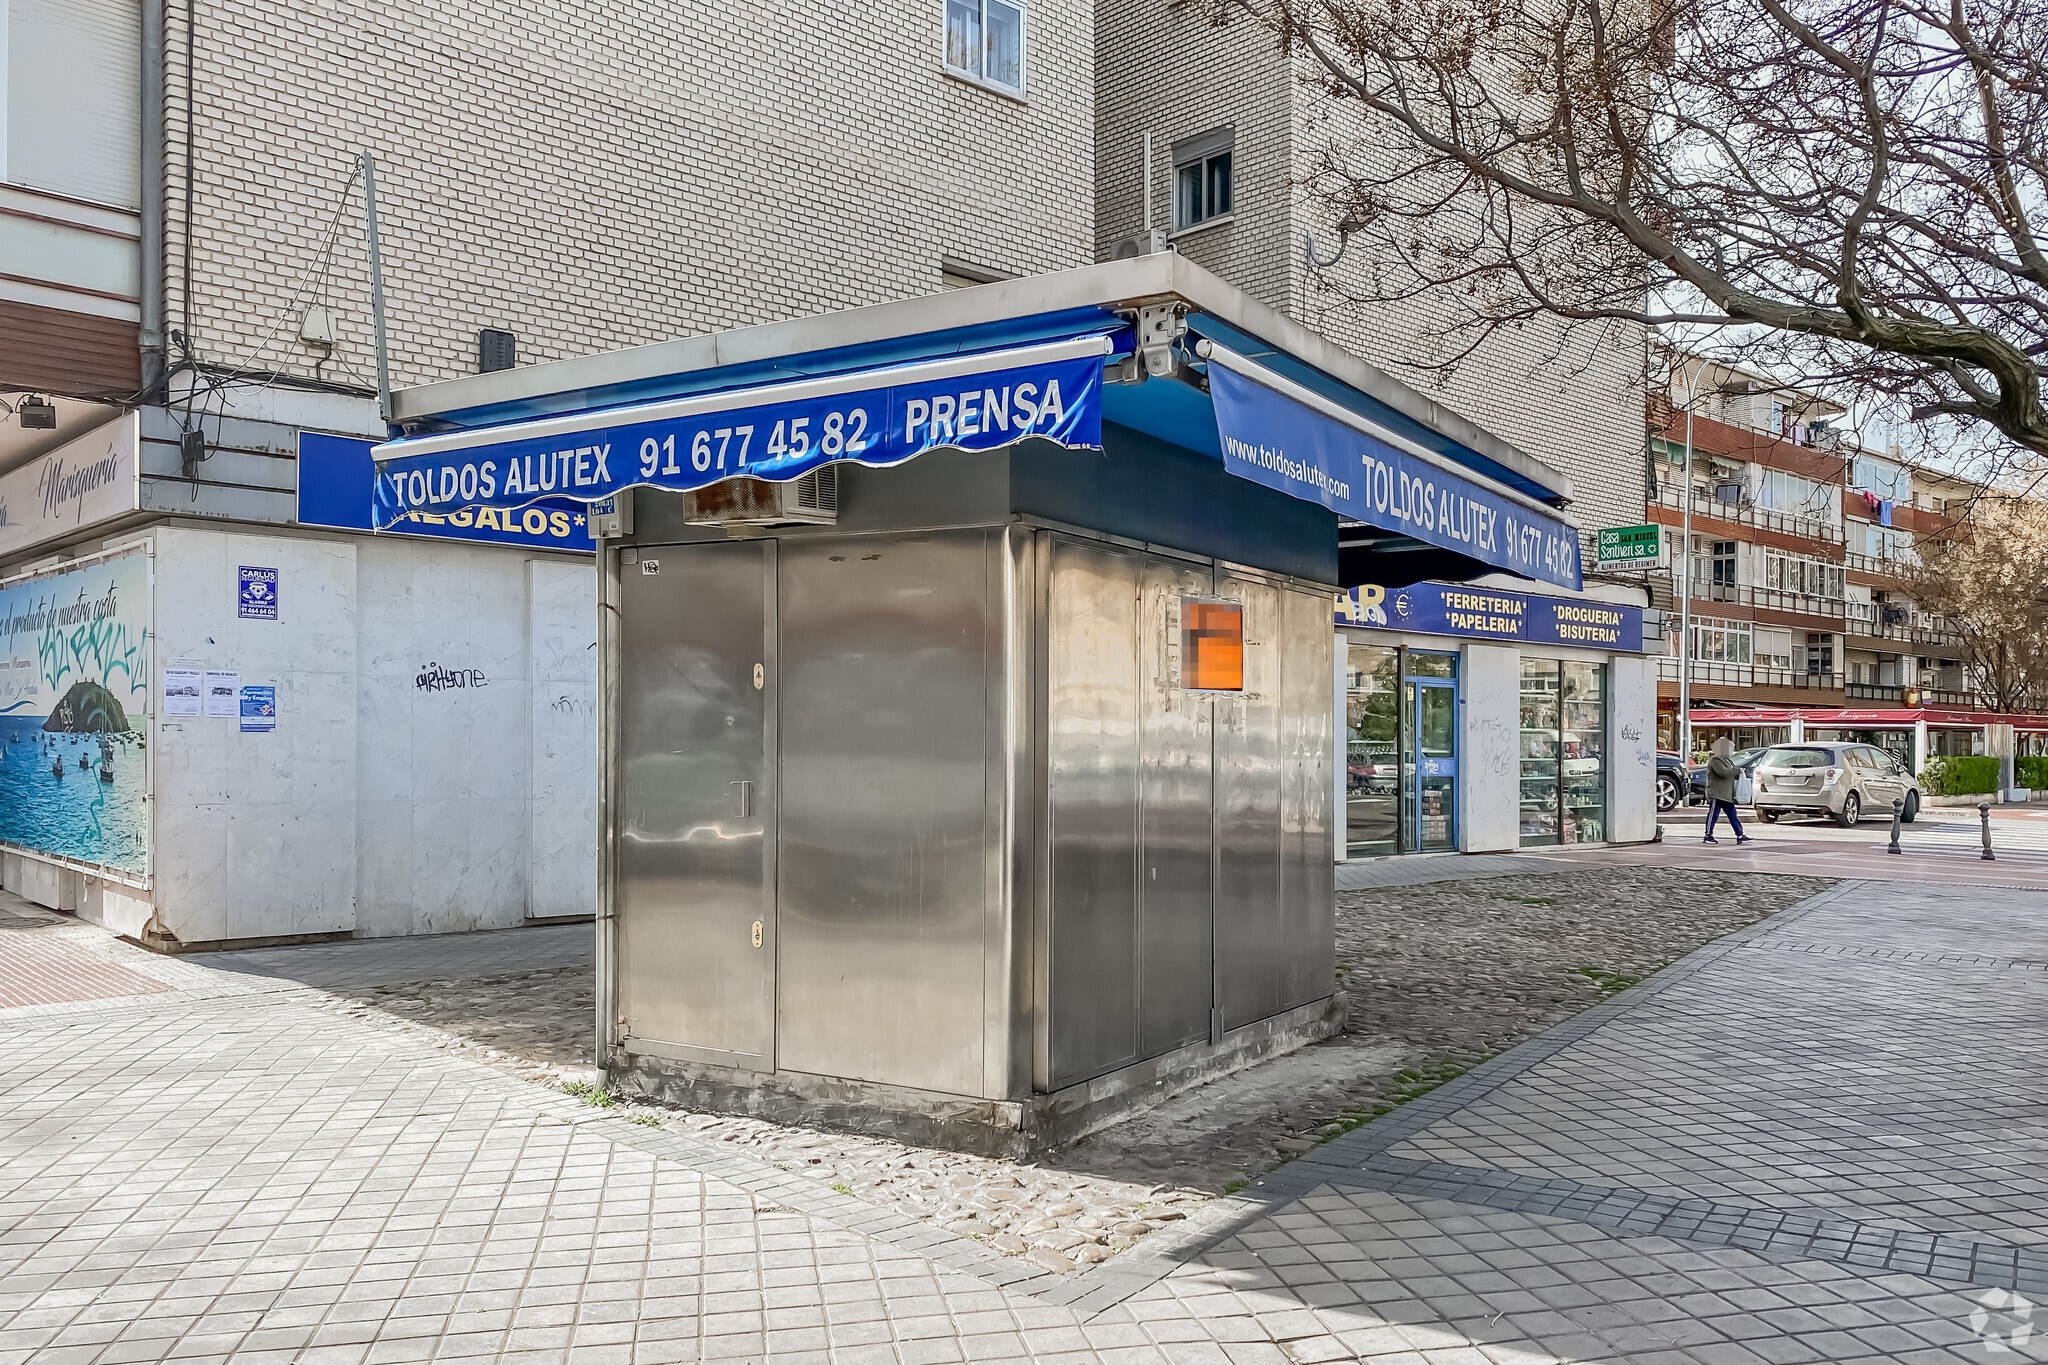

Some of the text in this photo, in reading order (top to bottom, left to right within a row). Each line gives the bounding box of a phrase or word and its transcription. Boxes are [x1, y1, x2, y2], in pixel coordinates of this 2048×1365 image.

[392, 379, 1065, 507] TOLDOS ALUTEX 91 677 45 82 PRENSA
[1225, 434, 1350, 501] www.toldosalutex.com
[38, 442, 118, 525] Marisquería
[1361, 454, 1574, 580] TOLDOS ALUTEX 91 677 45 82
[1600, 531, 1619, 545] Casa
[1601, 543, 1634, 559] Santiveri
[1628, 561, 1634, 569] DE
[10, 596, 46, 655] producto
[46, 593, 57, 630] de
[58, 587, 91, 627] nuestra
[93, 579, 119, 621] costa
